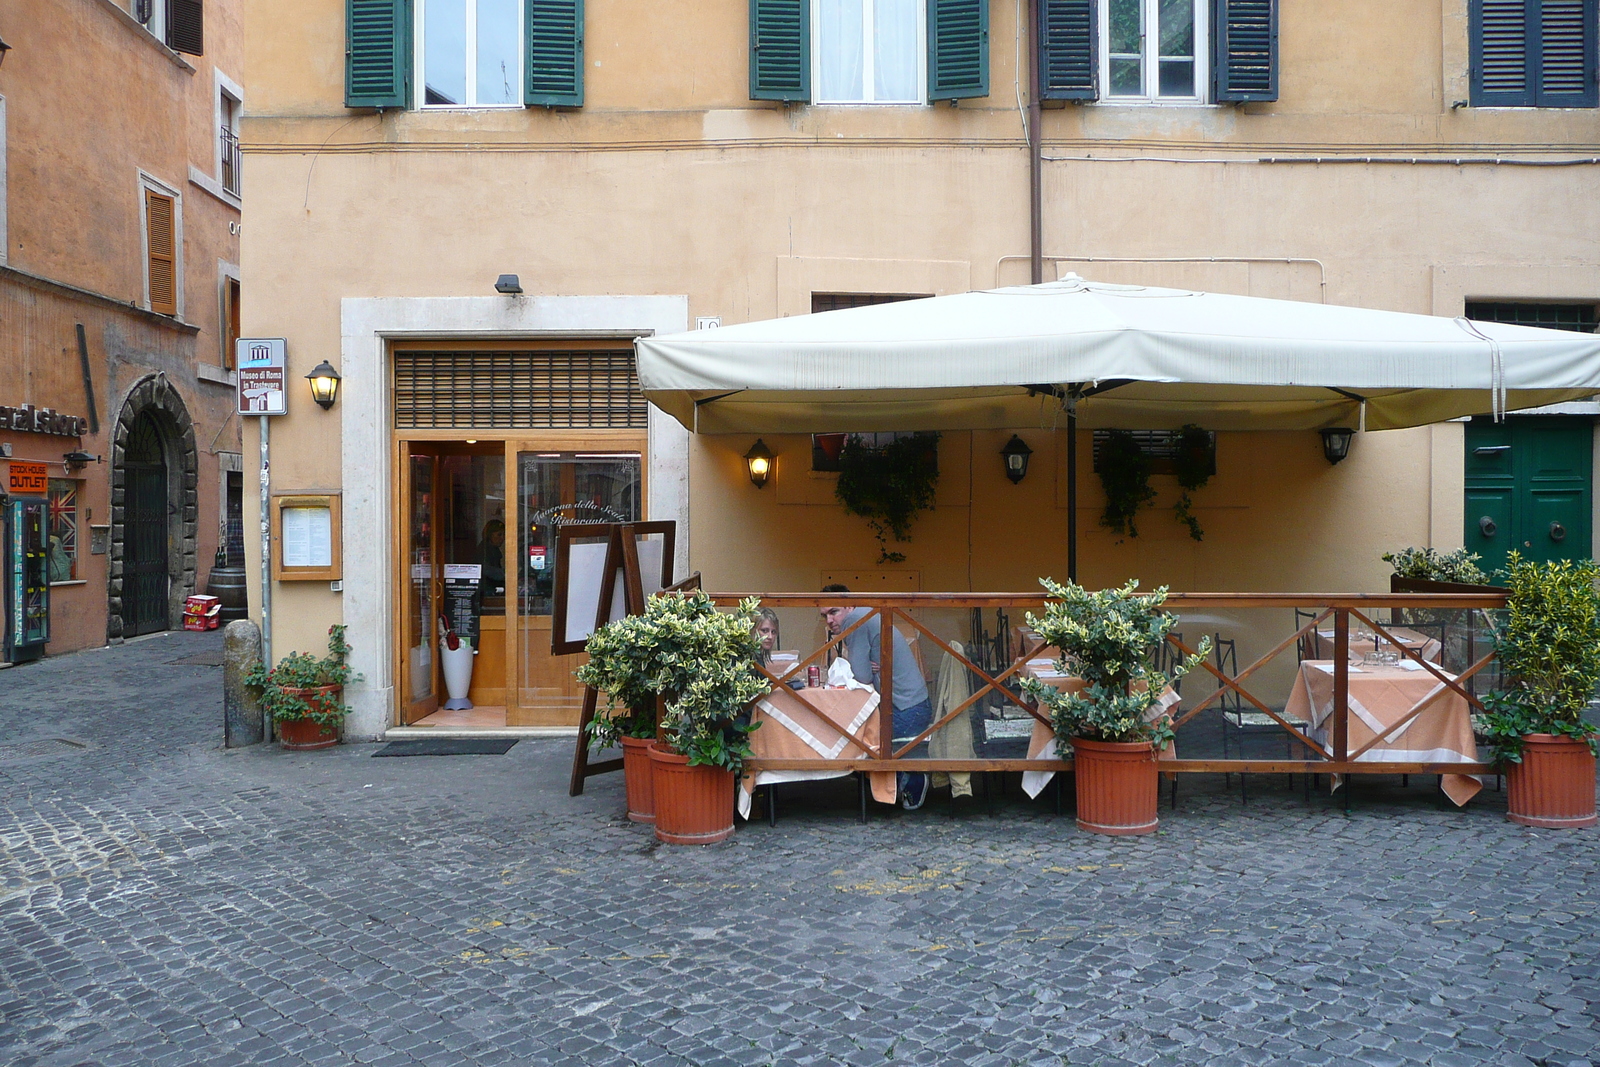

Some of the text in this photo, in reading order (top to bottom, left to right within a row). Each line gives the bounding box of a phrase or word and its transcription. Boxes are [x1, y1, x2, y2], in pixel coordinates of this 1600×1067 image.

[241, 371, 282, 380] Museo di Roma
[243, 381, 249, 389] in
[10, 465, 46, 475] STOCK HOUSE
[10, 476, 46, 488] OUTLET
[533, 500, 626, 524] Taverna della Scala
[550, 515, 608, 525] Ristorante
